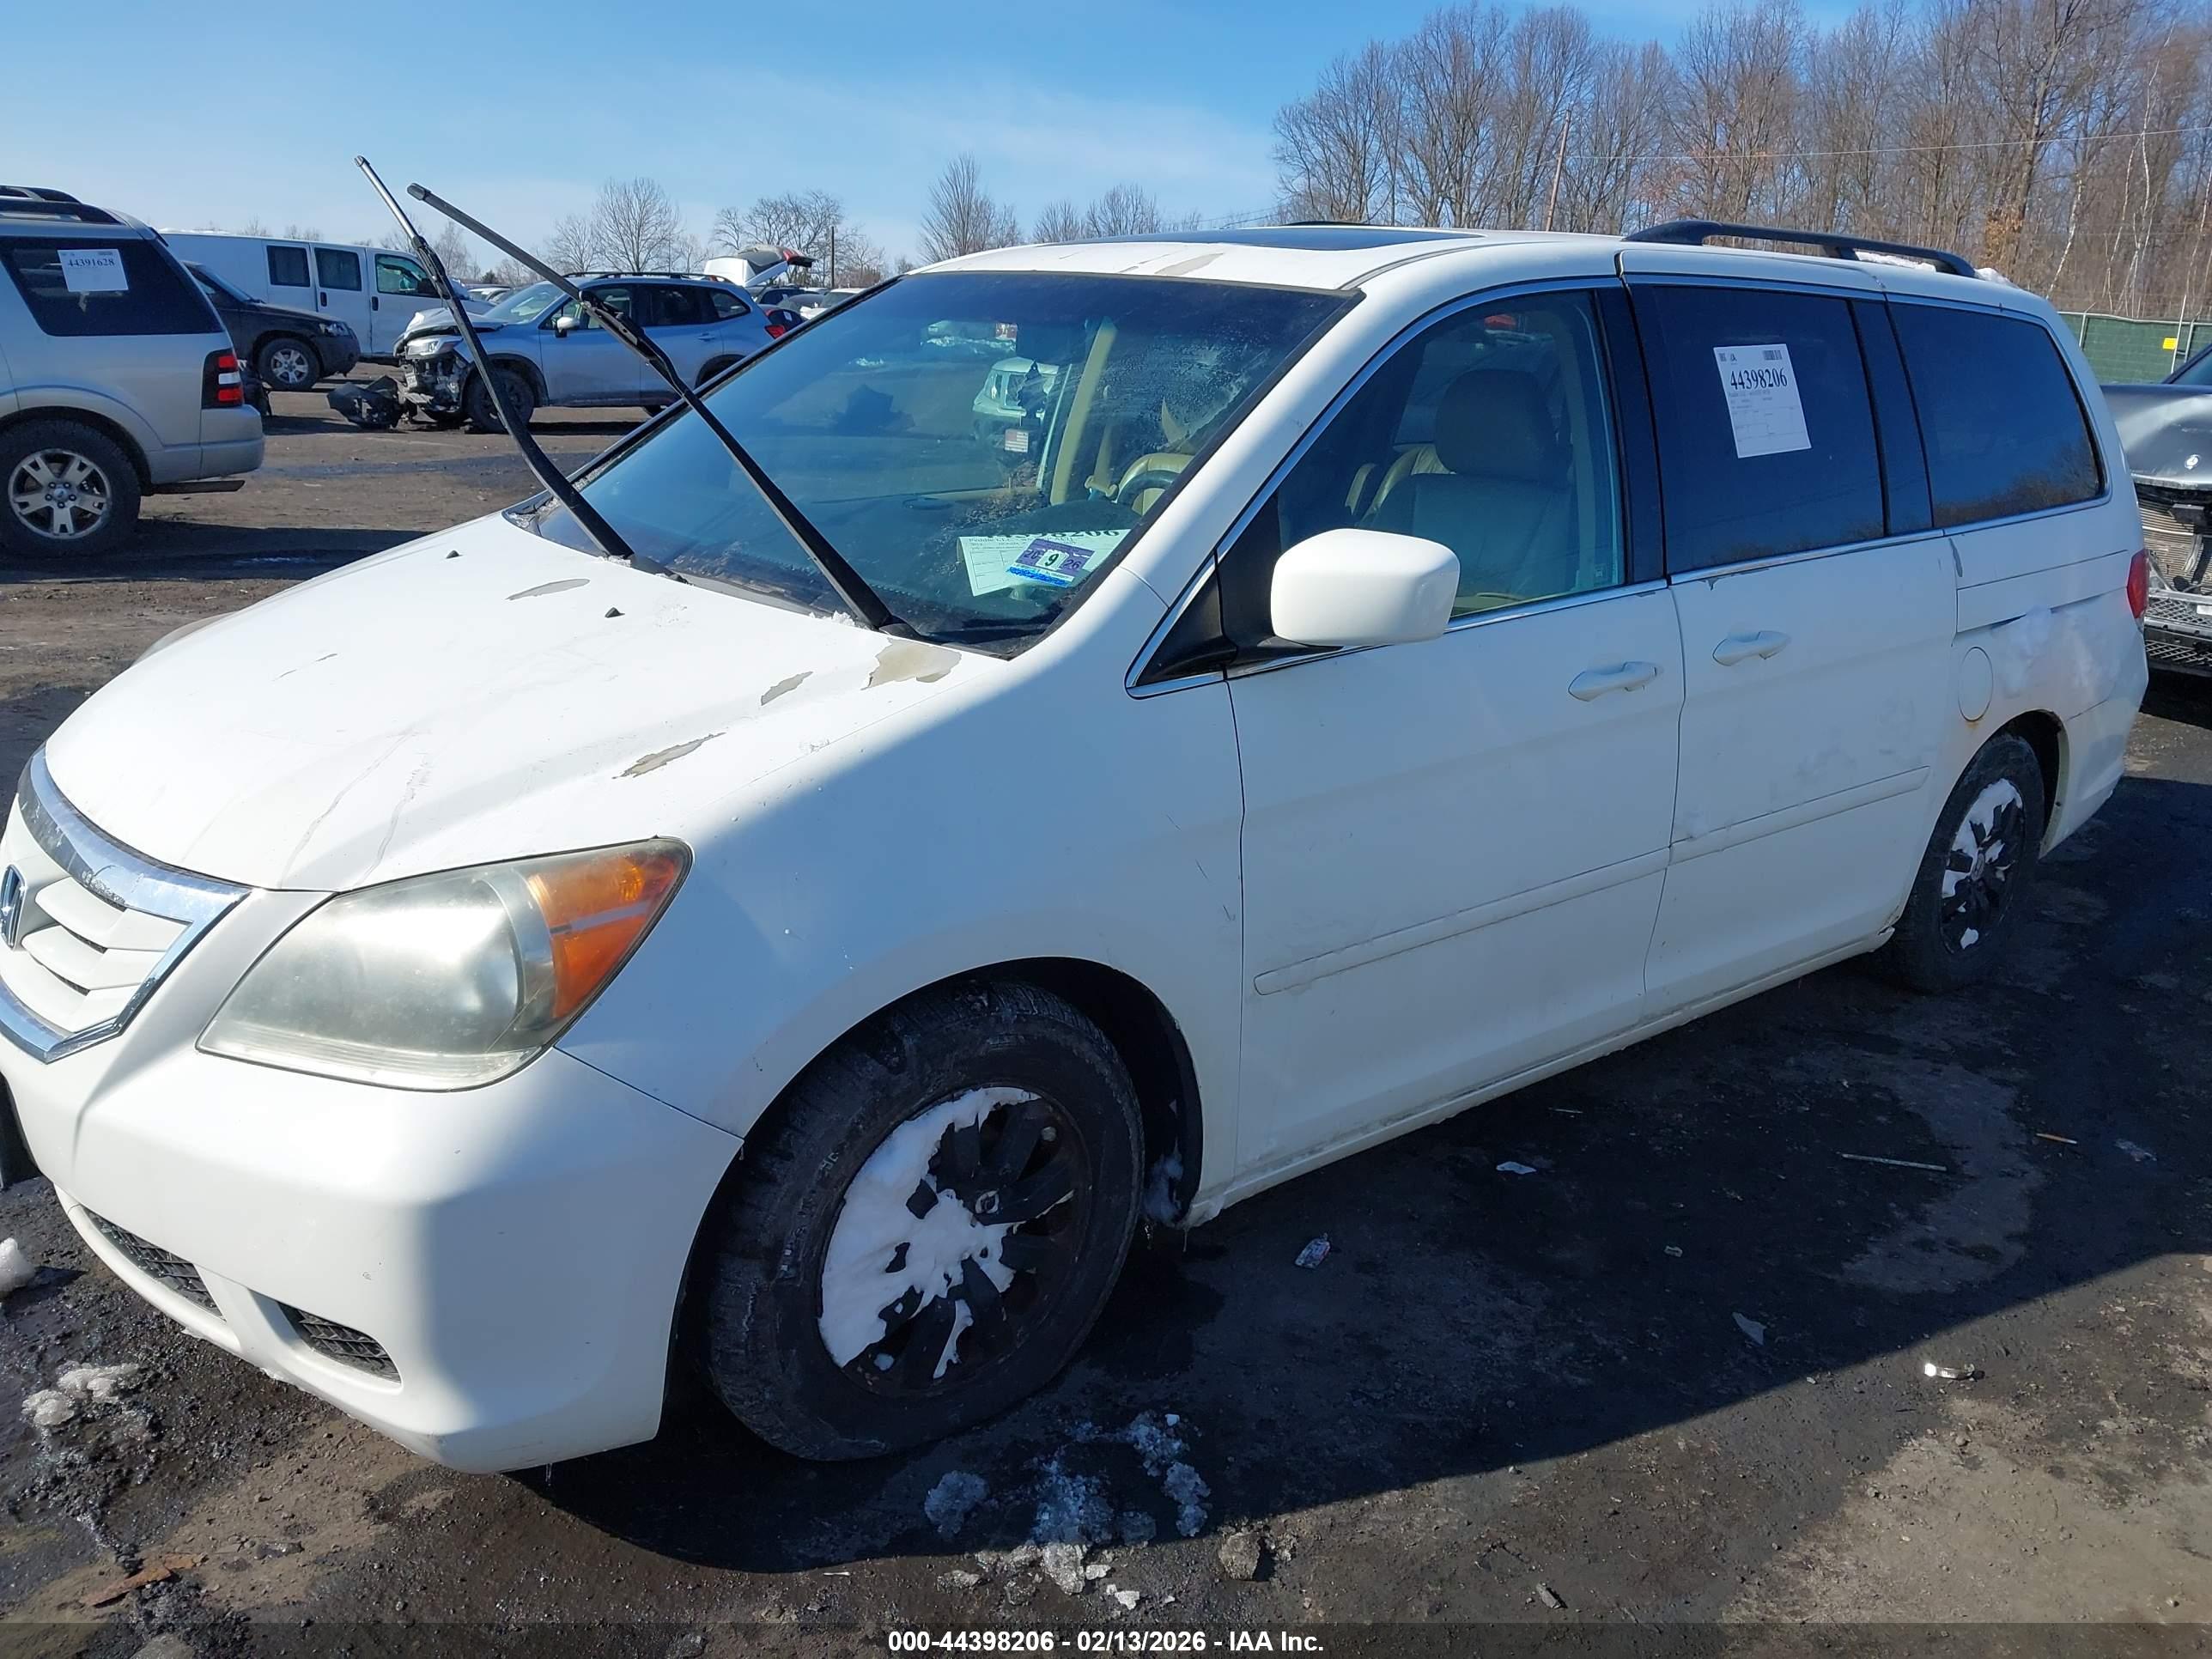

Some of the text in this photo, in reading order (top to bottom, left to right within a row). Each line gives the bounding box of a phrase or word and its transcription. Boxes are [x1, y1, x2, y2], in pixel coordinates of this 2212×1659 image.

[1729, 367, 1788, 391] 44398206
[1024, 550, 1082, 569] 20 9 26
